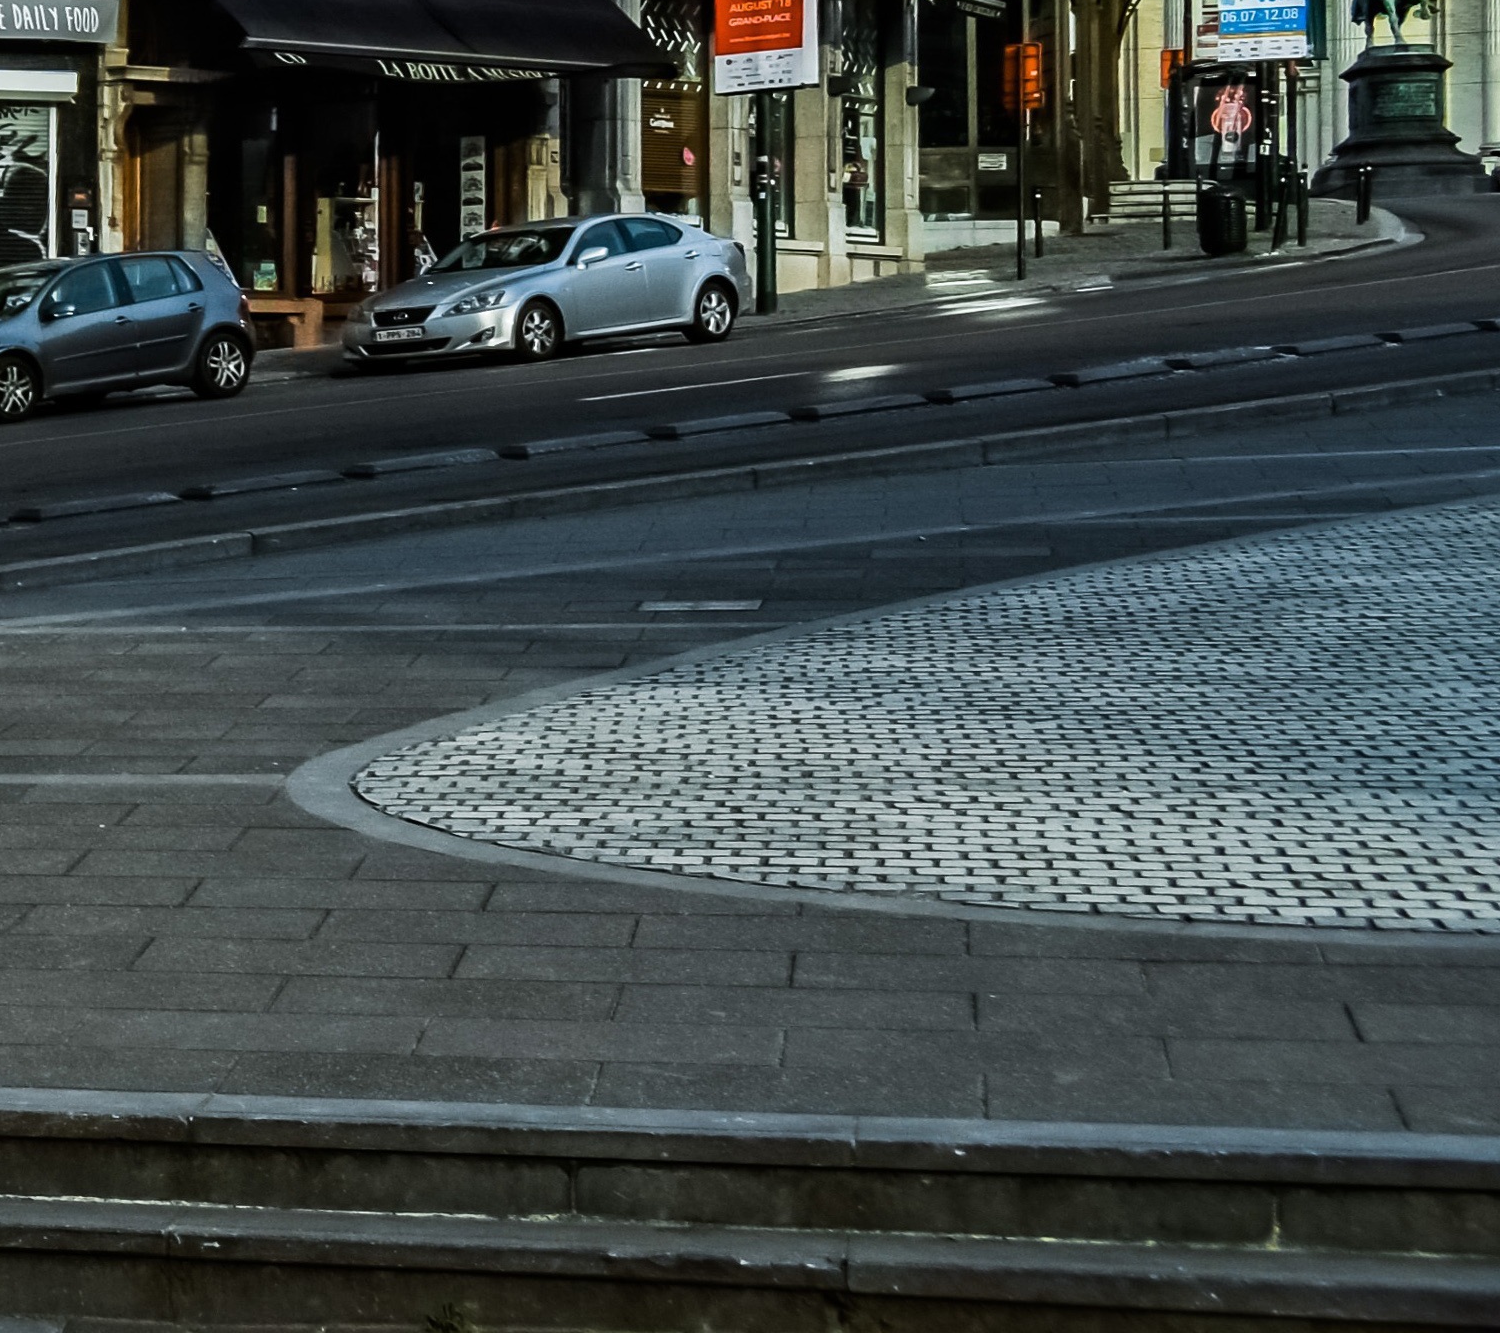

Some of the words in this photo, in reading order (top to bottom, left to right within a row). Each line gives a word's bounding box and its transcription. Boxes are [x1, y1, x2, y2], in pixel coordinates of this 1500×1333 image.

[729, 0, 773, 14] AUGUST
[1220, 10, 1257, 24] 06.07
[1263, 7, 1300, 21] 12.08
[11, 3, 60, 32] DAILY
[64, 5, 100, 33] FOOD
[377, 58, 405, 79] LA
